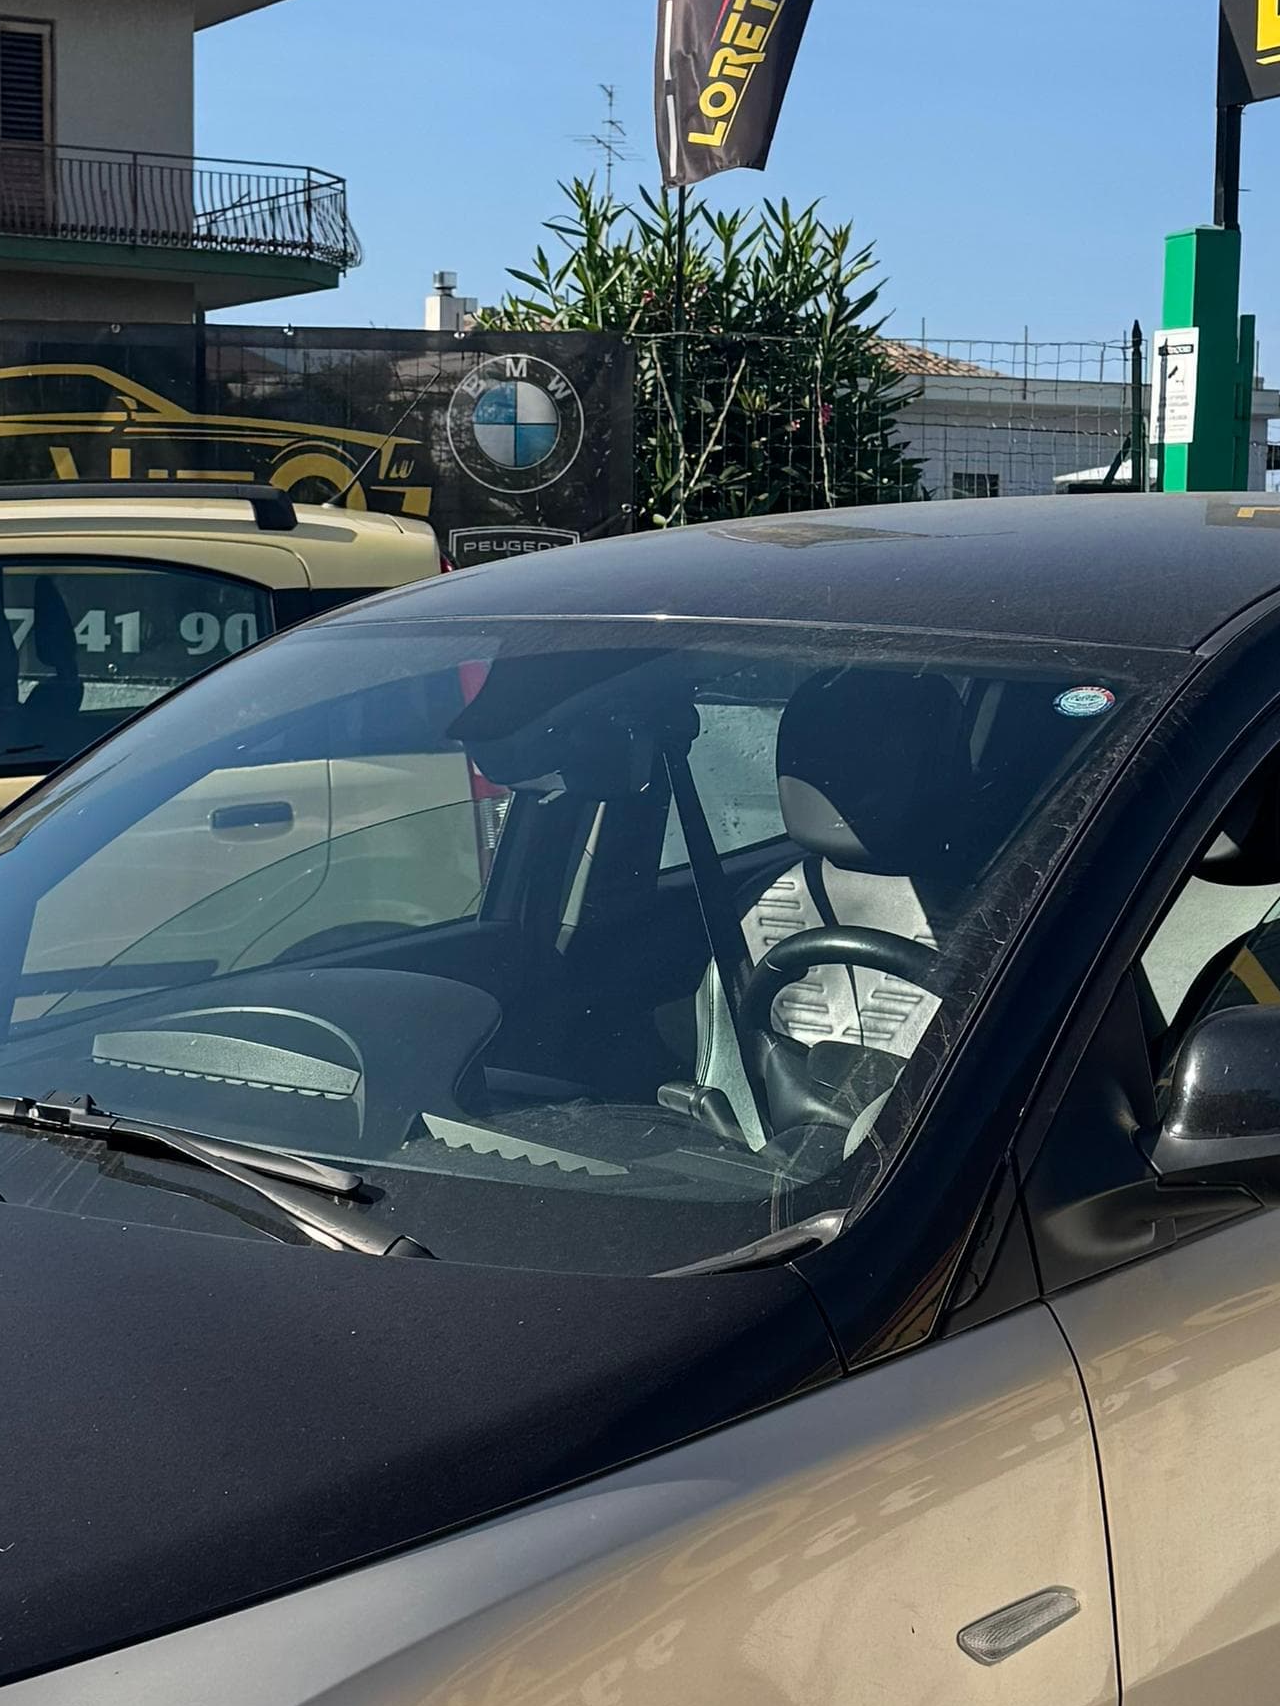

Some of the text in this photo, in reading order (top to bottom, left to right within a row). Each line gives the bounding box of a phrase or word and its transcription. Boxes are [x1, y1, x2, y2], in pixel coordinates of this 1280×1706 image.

[462, 358, 572, 401] BMW
[463, 540, 559, 553] PEUGEO
[73, 609, 141, 654] 41
